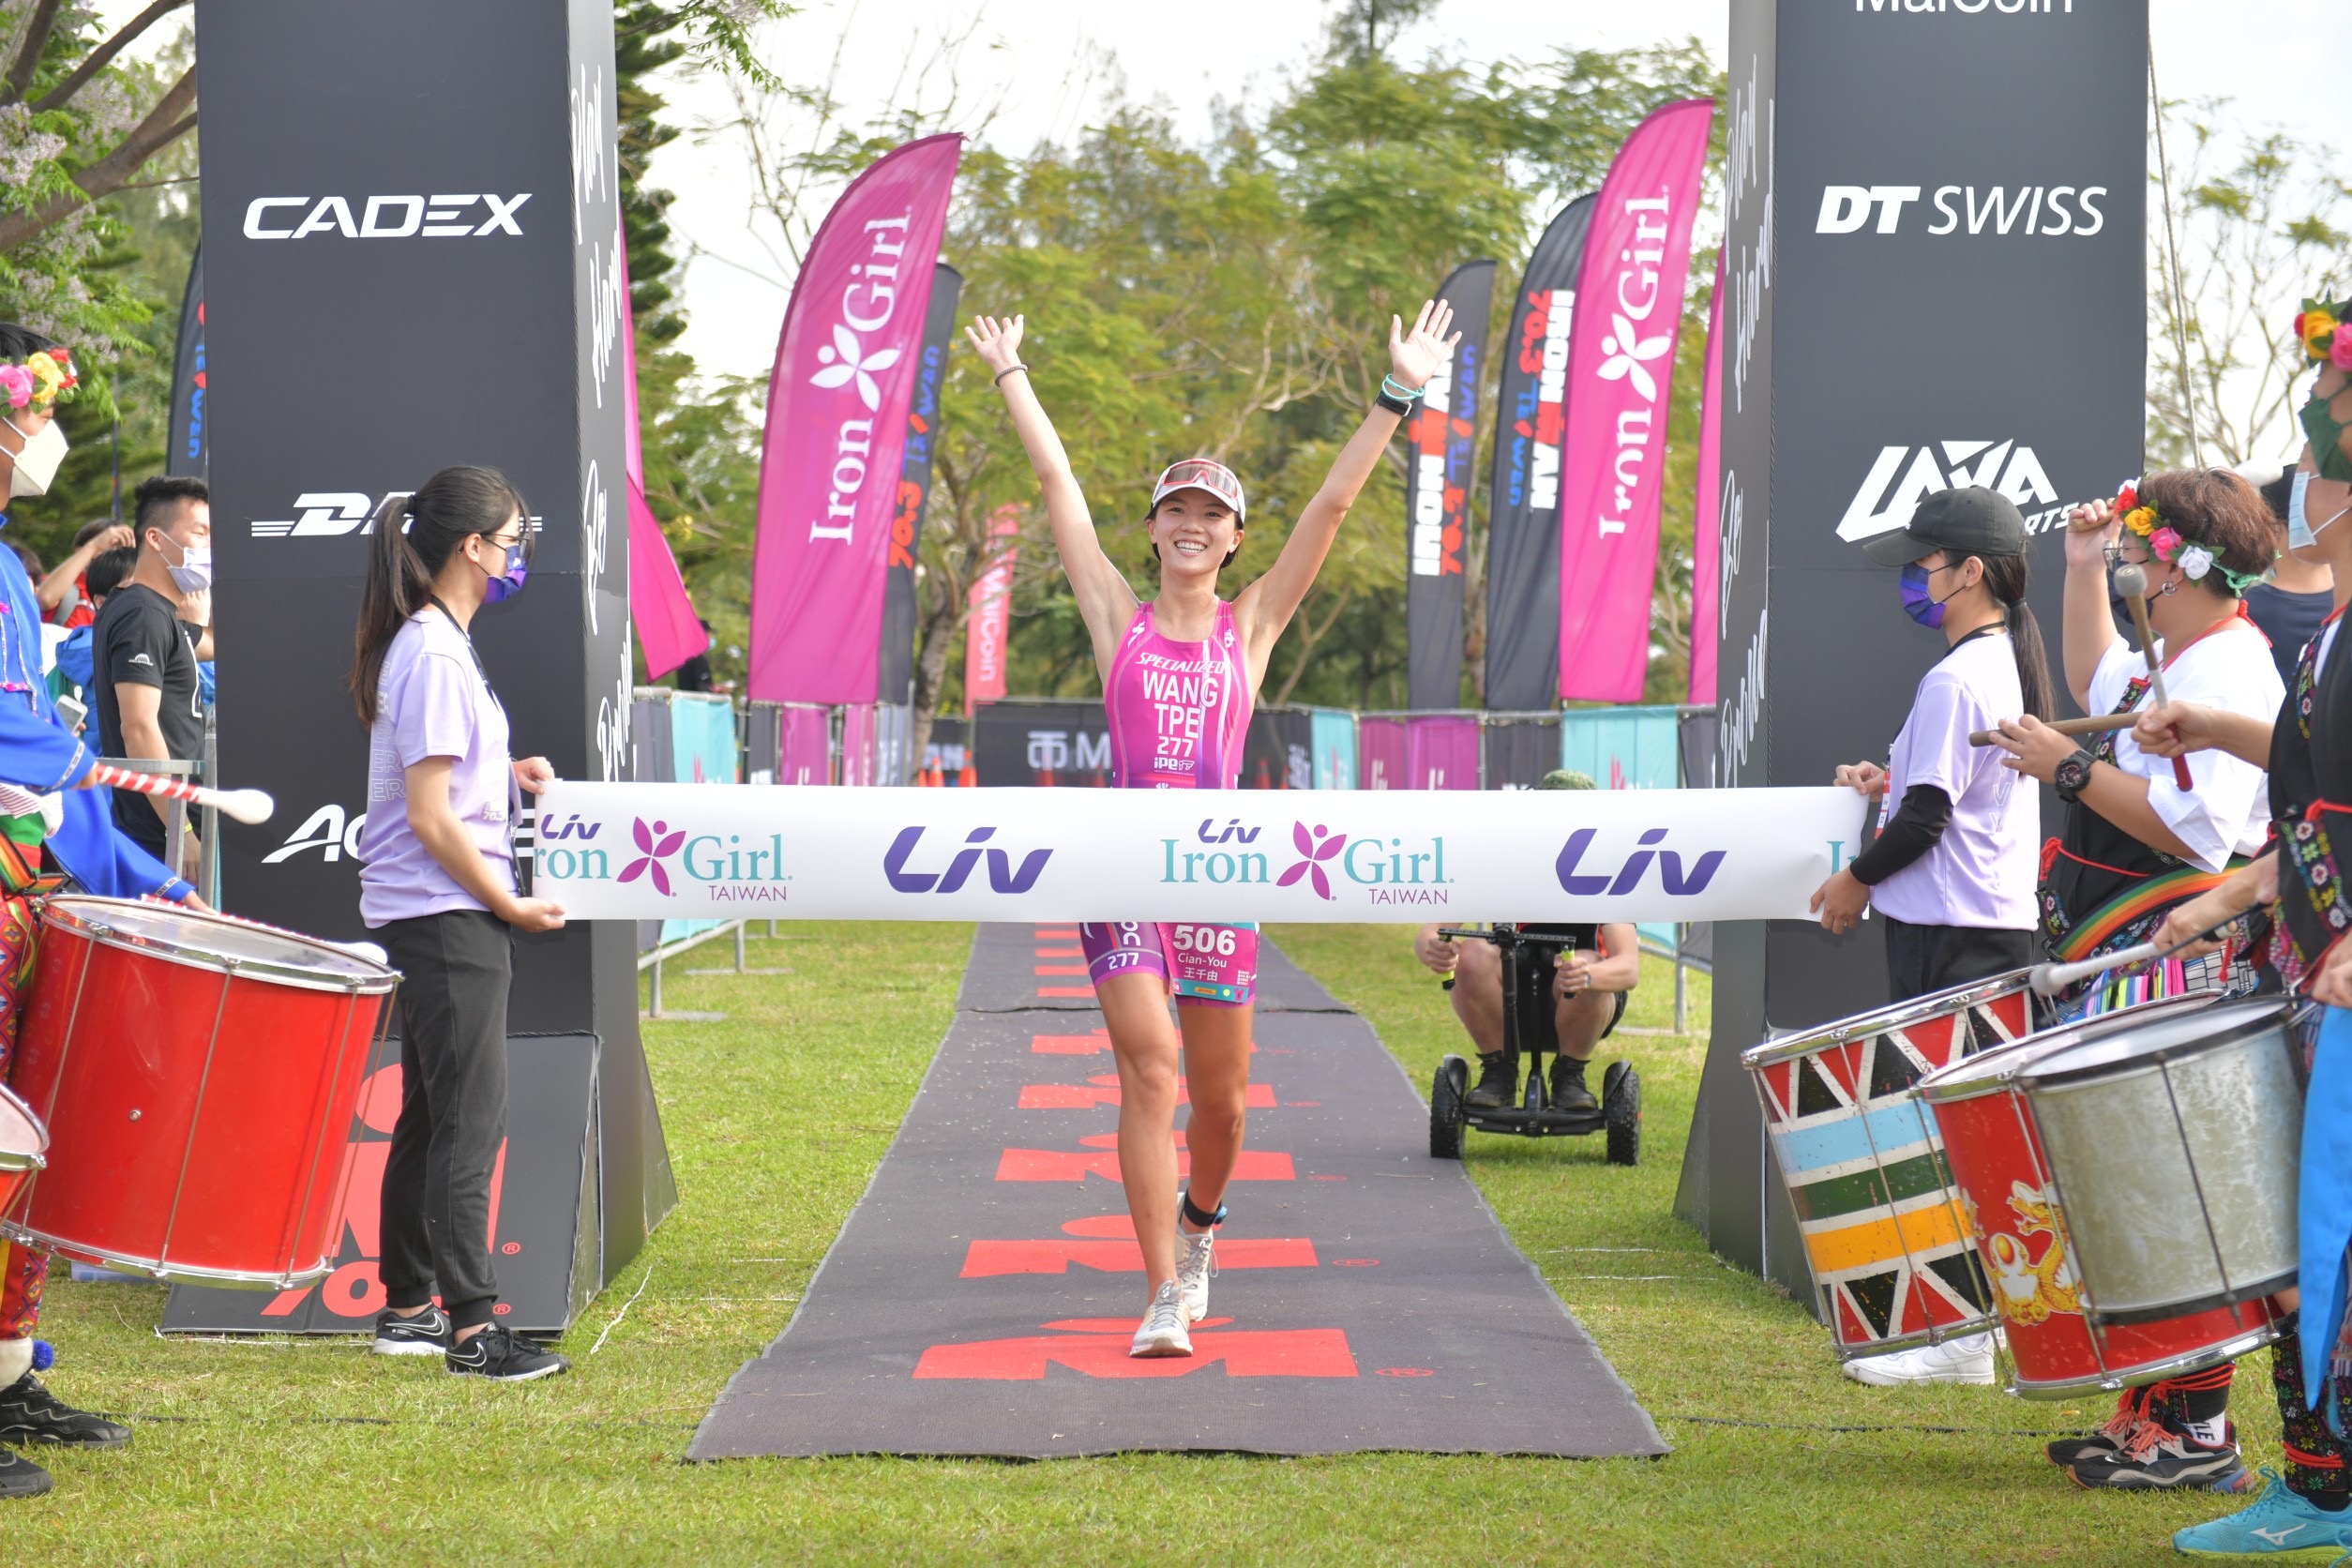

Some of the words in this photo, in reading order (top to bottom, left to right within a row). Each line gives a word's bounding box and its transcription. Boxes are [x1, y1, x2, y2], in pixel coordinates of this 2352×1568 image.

[243, 193, 533, 239] CADEX
[1816, 185, 1921, 234] DT
[1927, 185, 2107, 236] SWISS
[1617, 194, 1669, 321] Girl
[1519, 290, 1552, 379] 70.3
[809, 417, 873, 545] Iron
[842, 213, 912, 332] Girl
[1530, 290, 1576, 509] IRONMAN
[1599, 405, 1651, 539] Iron
[889, 479, 922, 570] 70.3
[1135, 652, 1225, 674] SPECIALIZED
[1142, 669, 1219, 708] WANG
[1153, 702, 1202, 739] TPE
[1156, 735, 1194, 758] 277
[540, 813, 602, 840] Liv
[1198, 818, 1262, 844] Liv
[534, 848, 611, 880] ron
[683, 833, 786, 881] Girl
[882, 826, 1054, 895] Liv
[1159, 838, 1272, 884] Iron
[1343, 836, 1448, 884] Girl
[1555, 828, 1727, 896] Liv
[708, 885, 787, 902] TAIWAN
[1368, 888, 1448, 905] TAIWAN
[1172, 924, 1236, 956] 506
[1177, 952, 1228, 969] Cian-You
[1108, 952, 1139, 971] 277
[1184, 967, 1218, 982] 王千由
